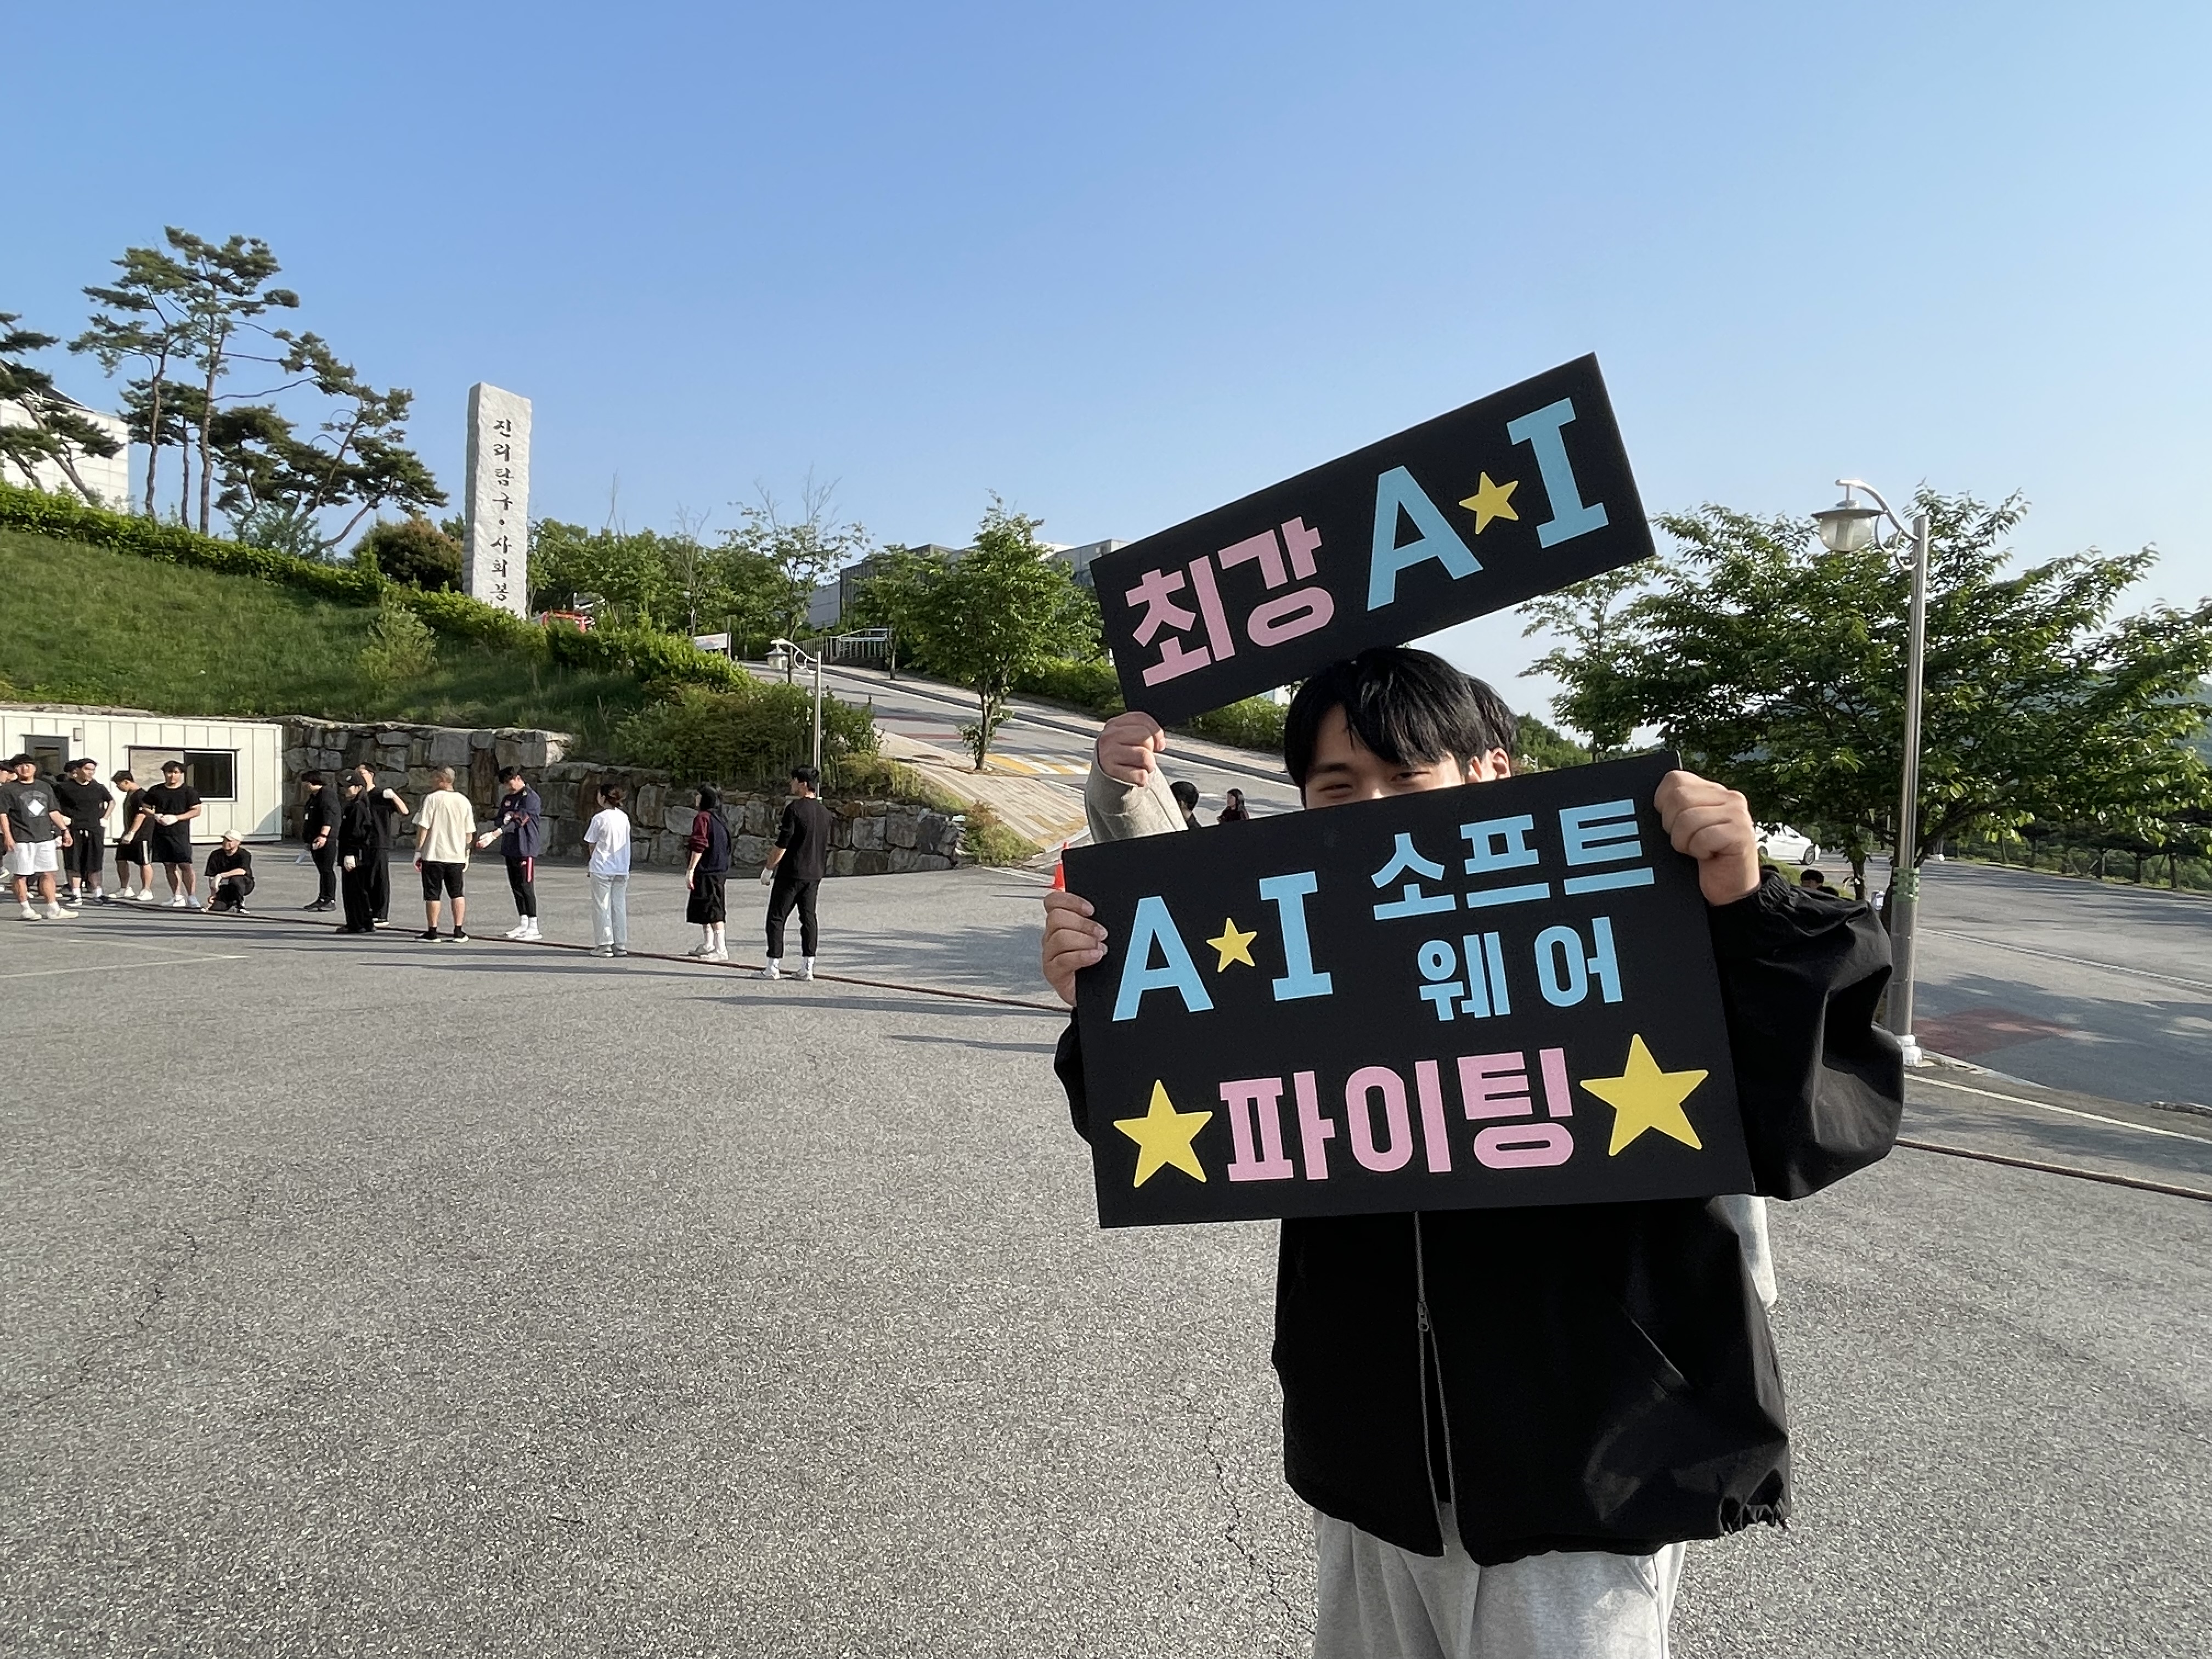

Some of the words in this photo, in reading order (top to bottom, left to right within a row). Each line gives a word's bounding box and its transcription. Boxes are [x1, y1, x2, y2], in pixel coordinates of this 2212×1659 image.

[1126, 517, 1334, 686] 최강
[1372, 799, 1654, 920] 소프트
[1220, 1048, 1574, 1182] 파이팅
